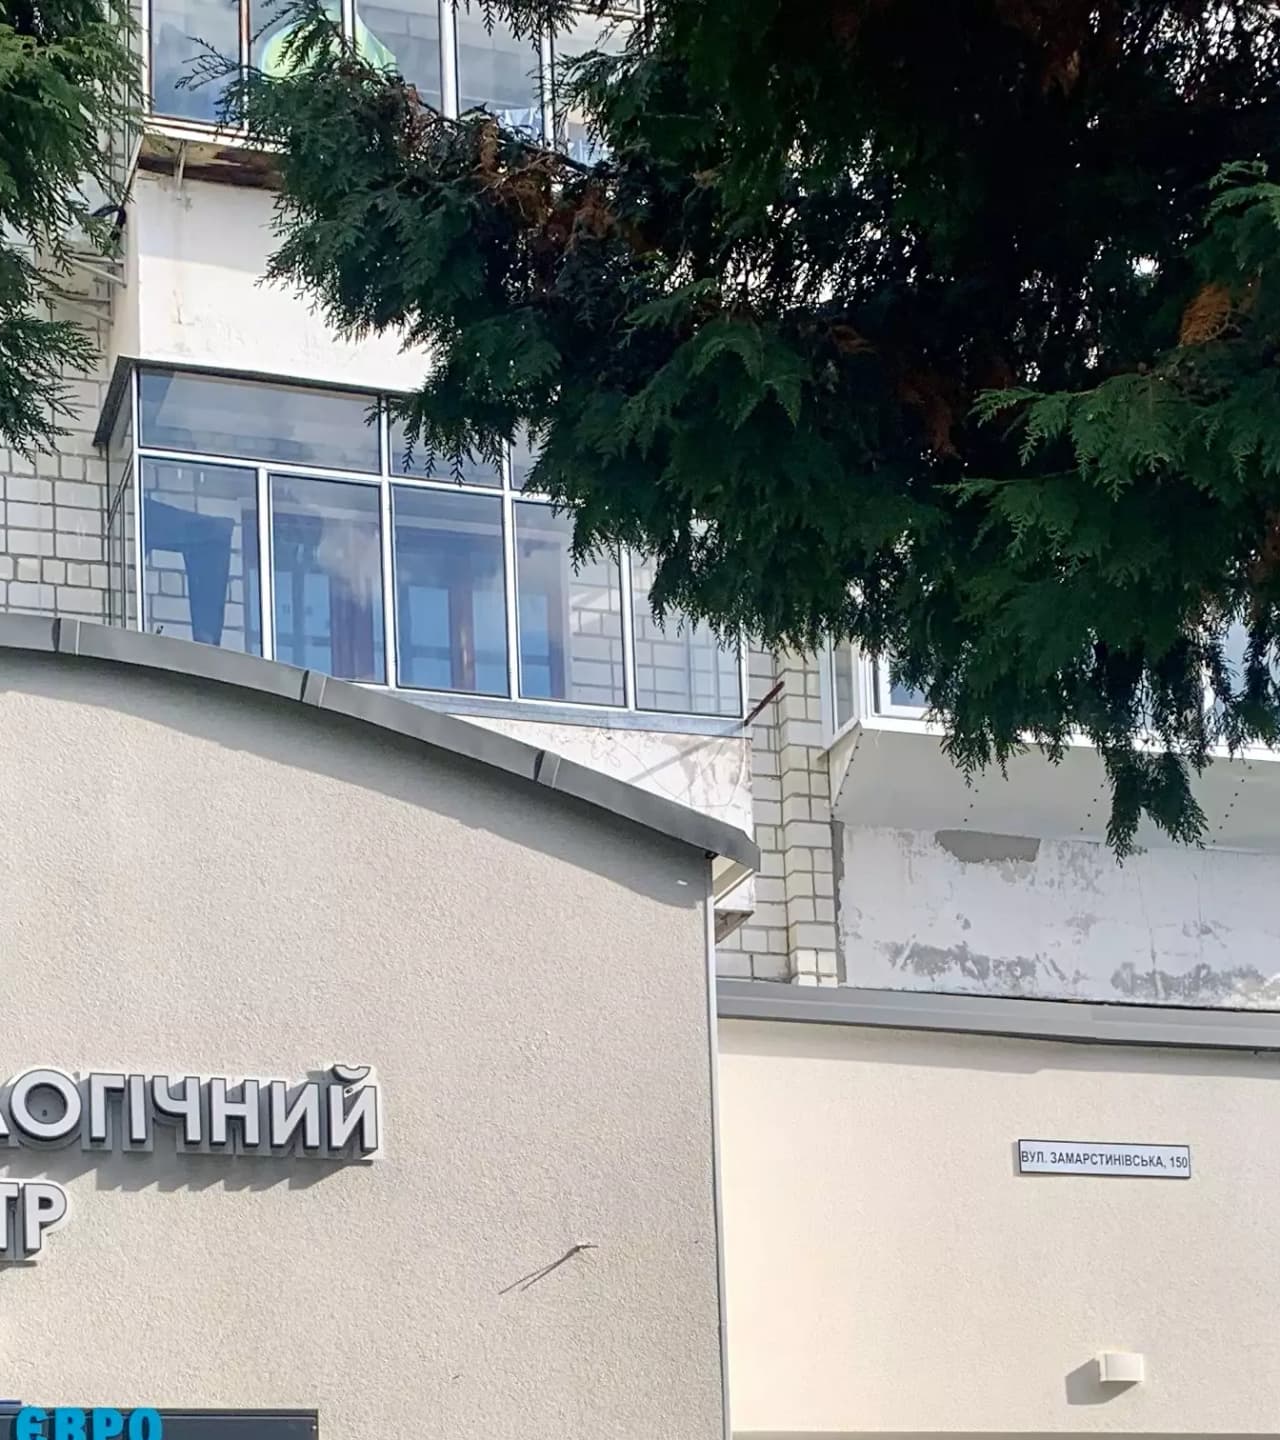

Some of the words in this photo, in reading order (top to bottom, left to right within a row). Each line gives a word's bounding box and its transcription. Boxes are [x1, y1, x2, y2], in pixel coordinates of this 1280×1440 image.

[1021, 1151, 1048, 1164] ВУЛ.
[1050, 1151, 1167, 1169] ЗАМАРСТИНІВСЬКА,
[1170, 1156, 1188, 1169] 150
